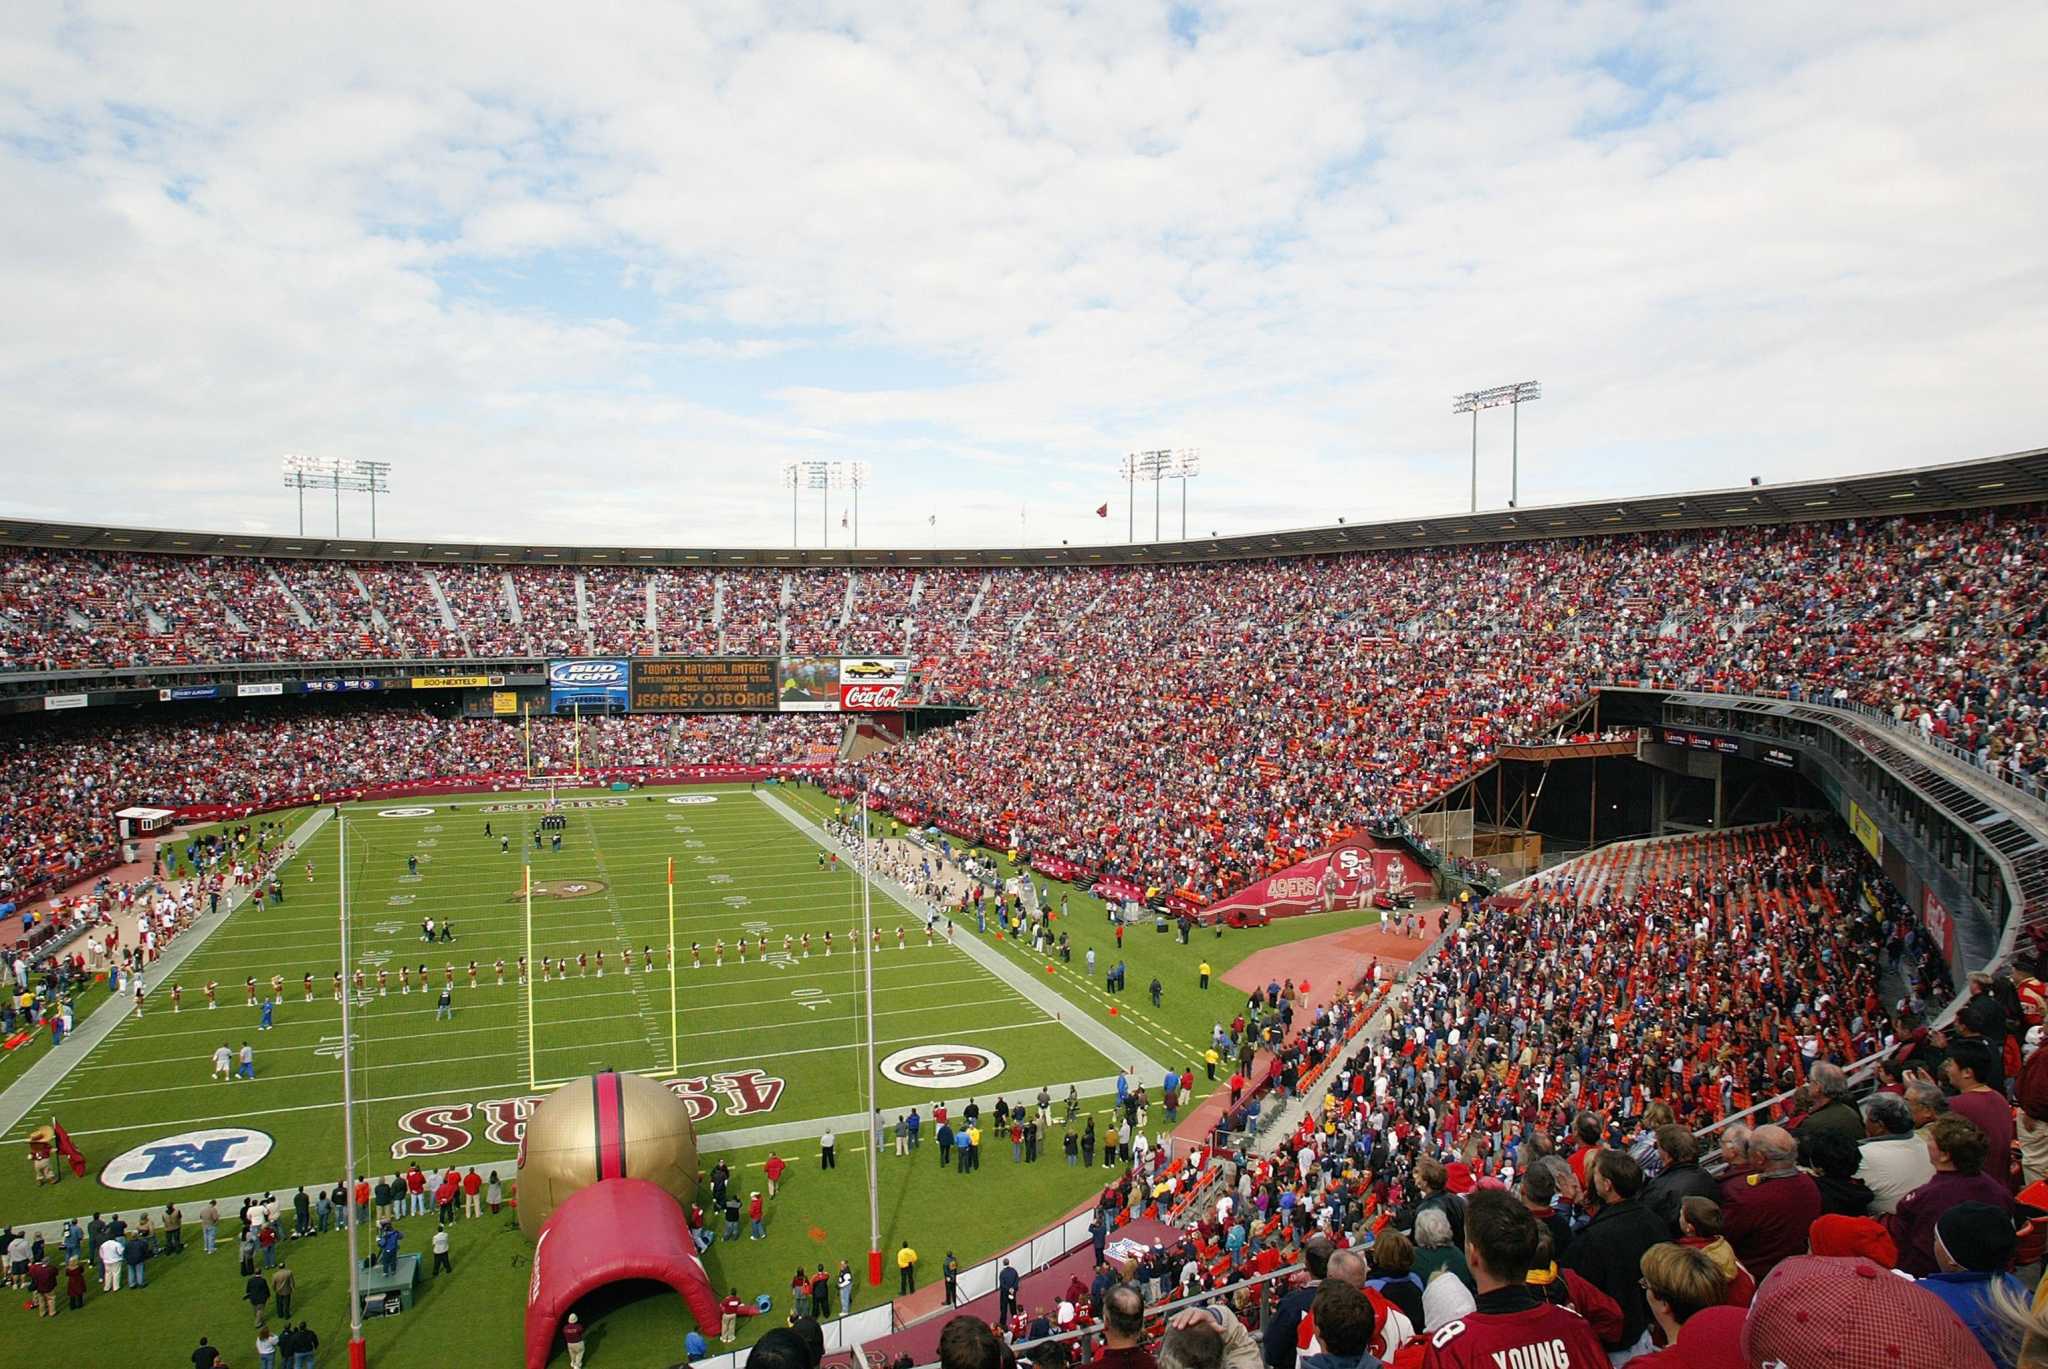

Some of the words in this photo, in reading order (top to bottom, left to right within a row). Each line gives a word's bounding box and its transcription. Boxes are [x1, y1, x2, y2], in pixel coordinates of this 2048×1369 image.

[569, 664, 616, 673] BUD
[684, 664, 728, 674] NATIONAL
[559, 672, 622, 681] LIGHT
[635, 693, 698, 706] JEFFREY
[702, 692, 775, 705] OSBORNE
[1267, 876, 1316, 898] 49ERS
[1490, 1338, 1571, 1369] YOUNG
